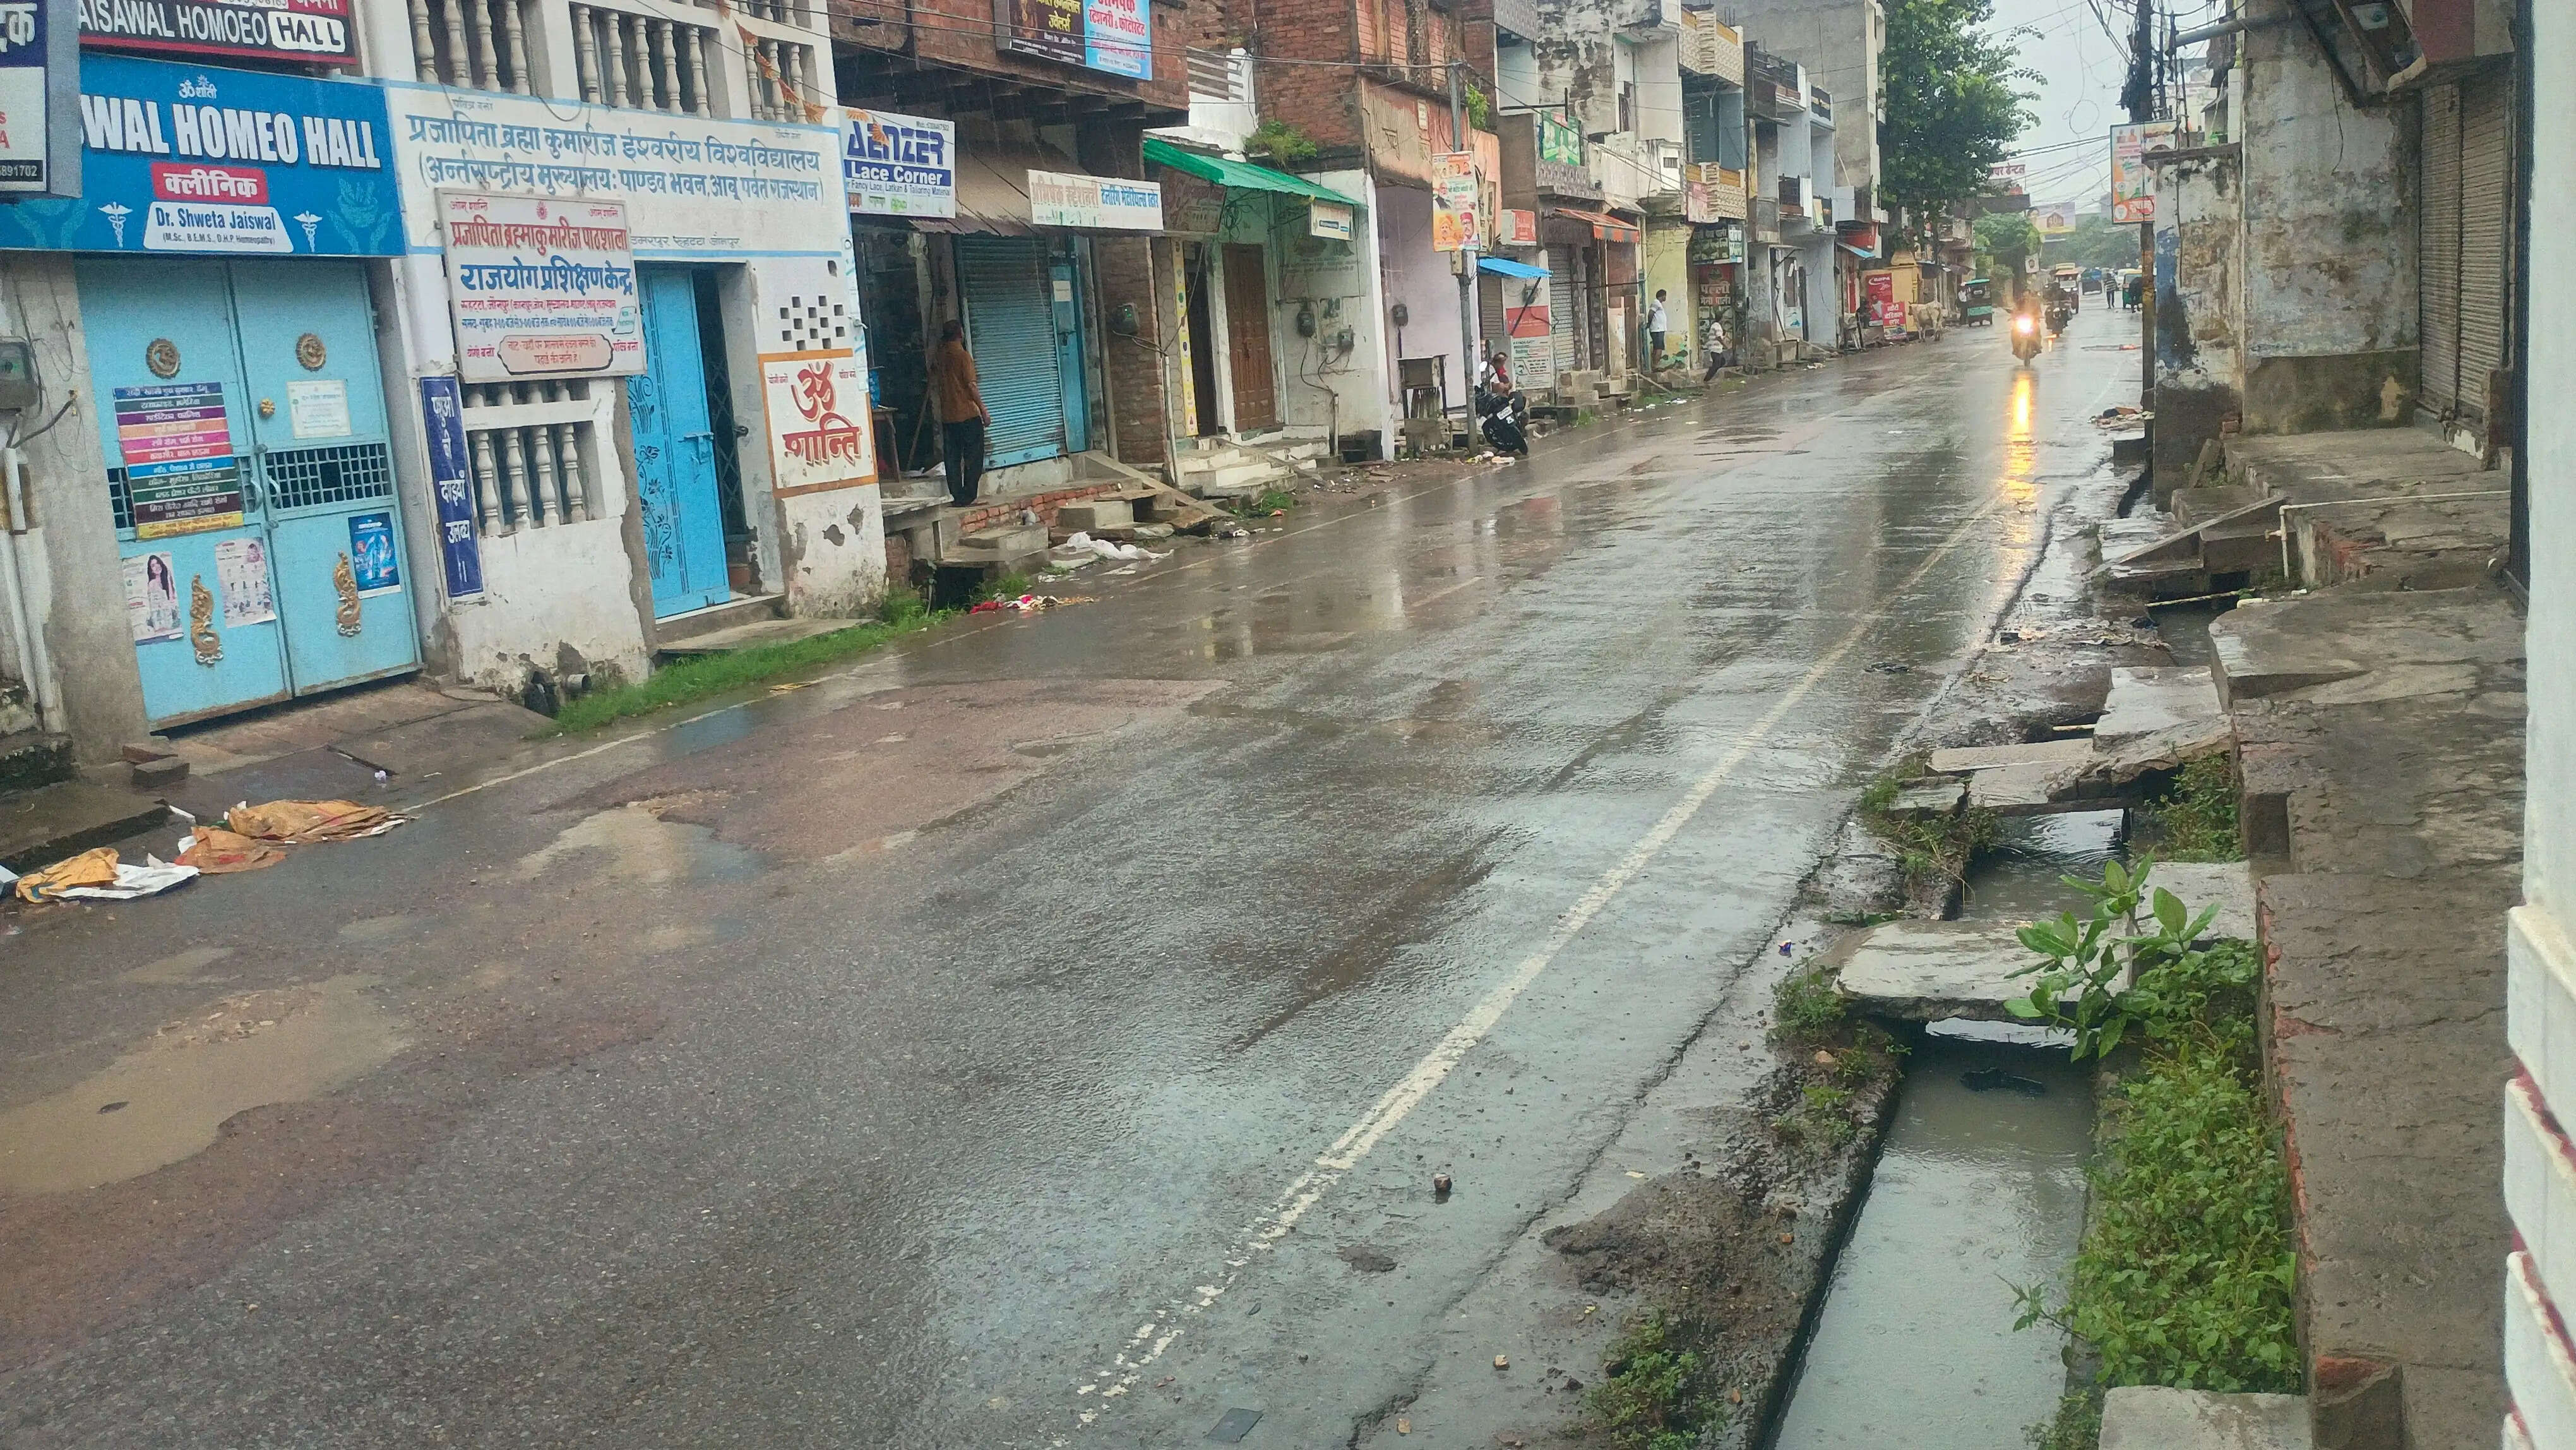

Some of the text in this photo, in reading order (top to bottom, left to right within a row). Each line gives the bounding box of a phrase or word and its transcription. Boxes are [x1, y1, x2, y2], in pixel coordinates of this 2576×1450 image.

[77, 0, 174, 37] AISAWAL
[177, 6, 267, 45] HOMOEO
[277, 16, 340, 45] HALL
[80, 95, 381, 169] WAL HOMEO HALL
[405, 111, 820, 172] प्रजापिता ब्रह्मा कुमारीज ईश्वरीय विश्वविद्यालय
[163, 169, 258, 198] क्लीनिक
[618, 169, 666, 193] पाण्डव
[851, 162, 943, 185] Lace Corner
[852, 180, 868, 191] Fancy
[155, 207, 275, 230] Dr. Shweta Jaiswal
[450, 214, 501, 248] प्रजापिता
[583, 227, 627, 250] पाठशाला
[460, 255, 633, 296] राजयोग प्रशिक्षण केन्द्र
[782, 411, 863, 467] शान्ति
